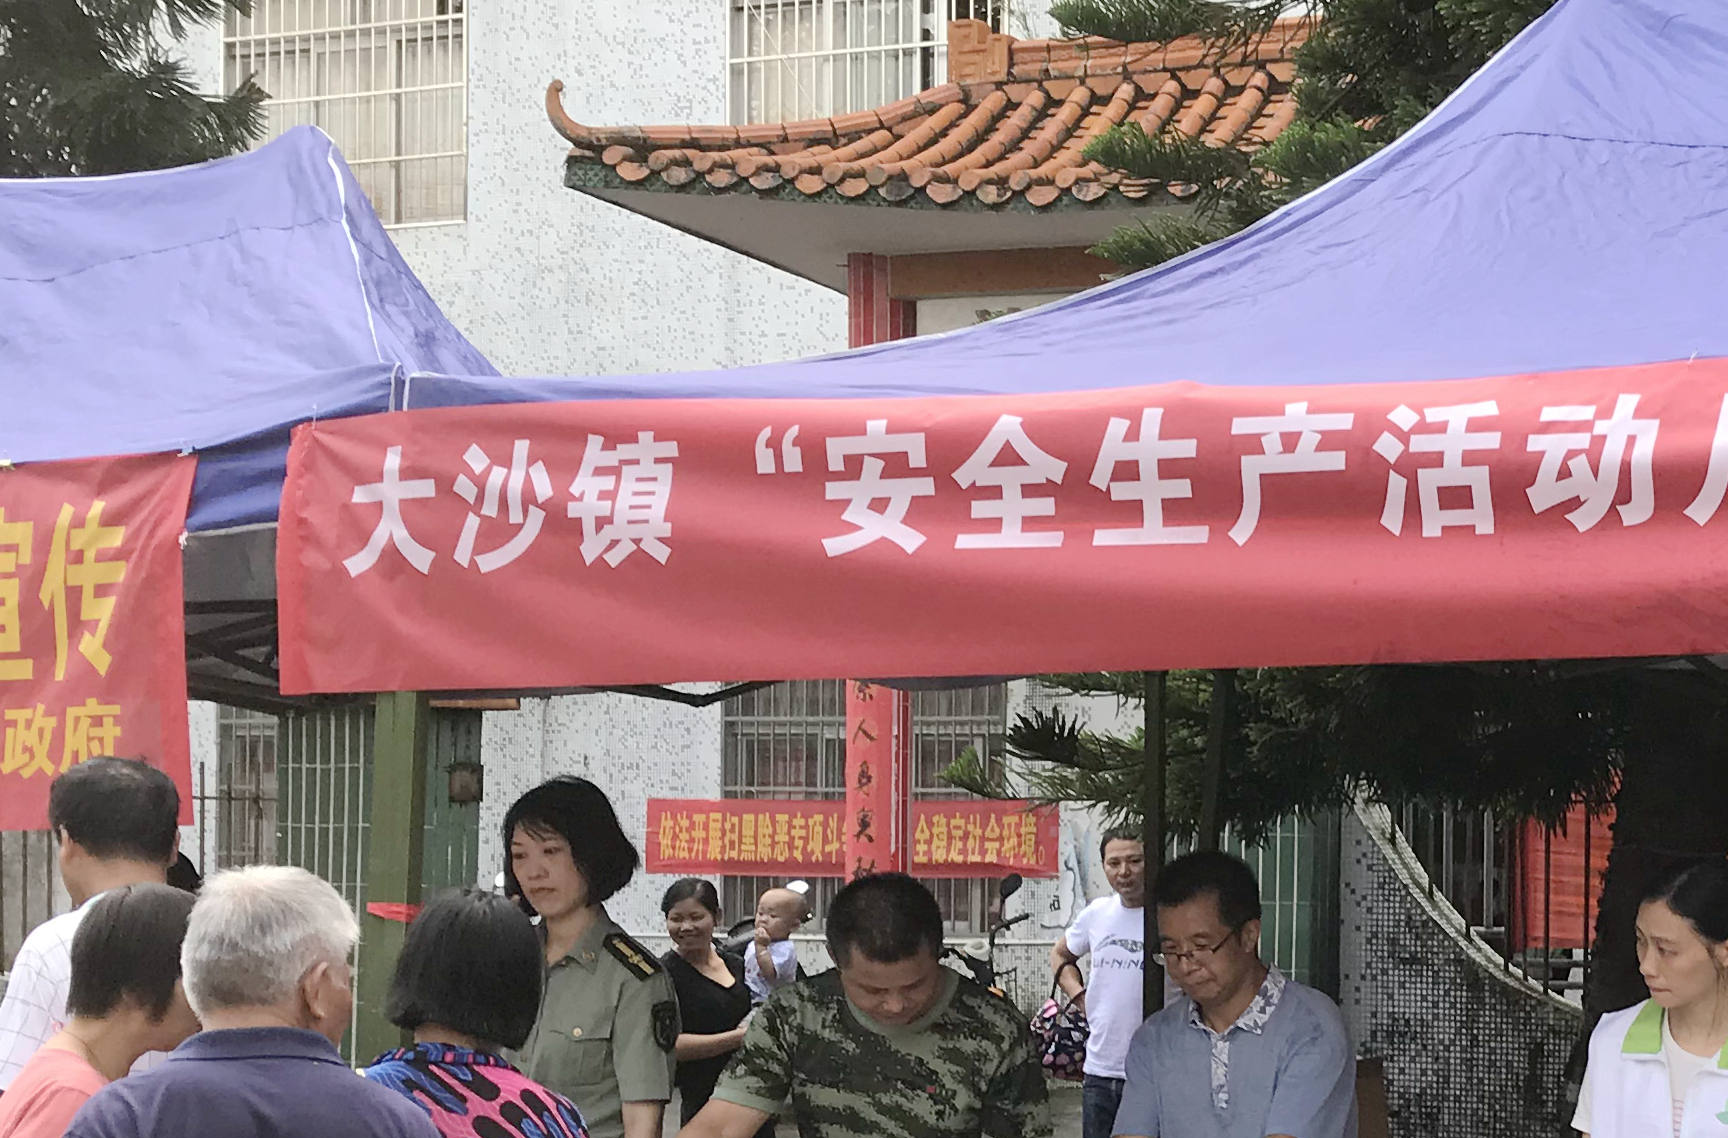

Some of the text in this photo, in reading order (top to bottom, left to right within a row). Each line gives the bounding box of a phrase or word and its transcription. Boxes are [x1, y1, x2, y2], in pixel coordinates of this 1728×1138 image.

[342, 431, 679, 578] 大沙镇
[658, 810, 847, 864] 依法开展扫黑除恶专项斗
